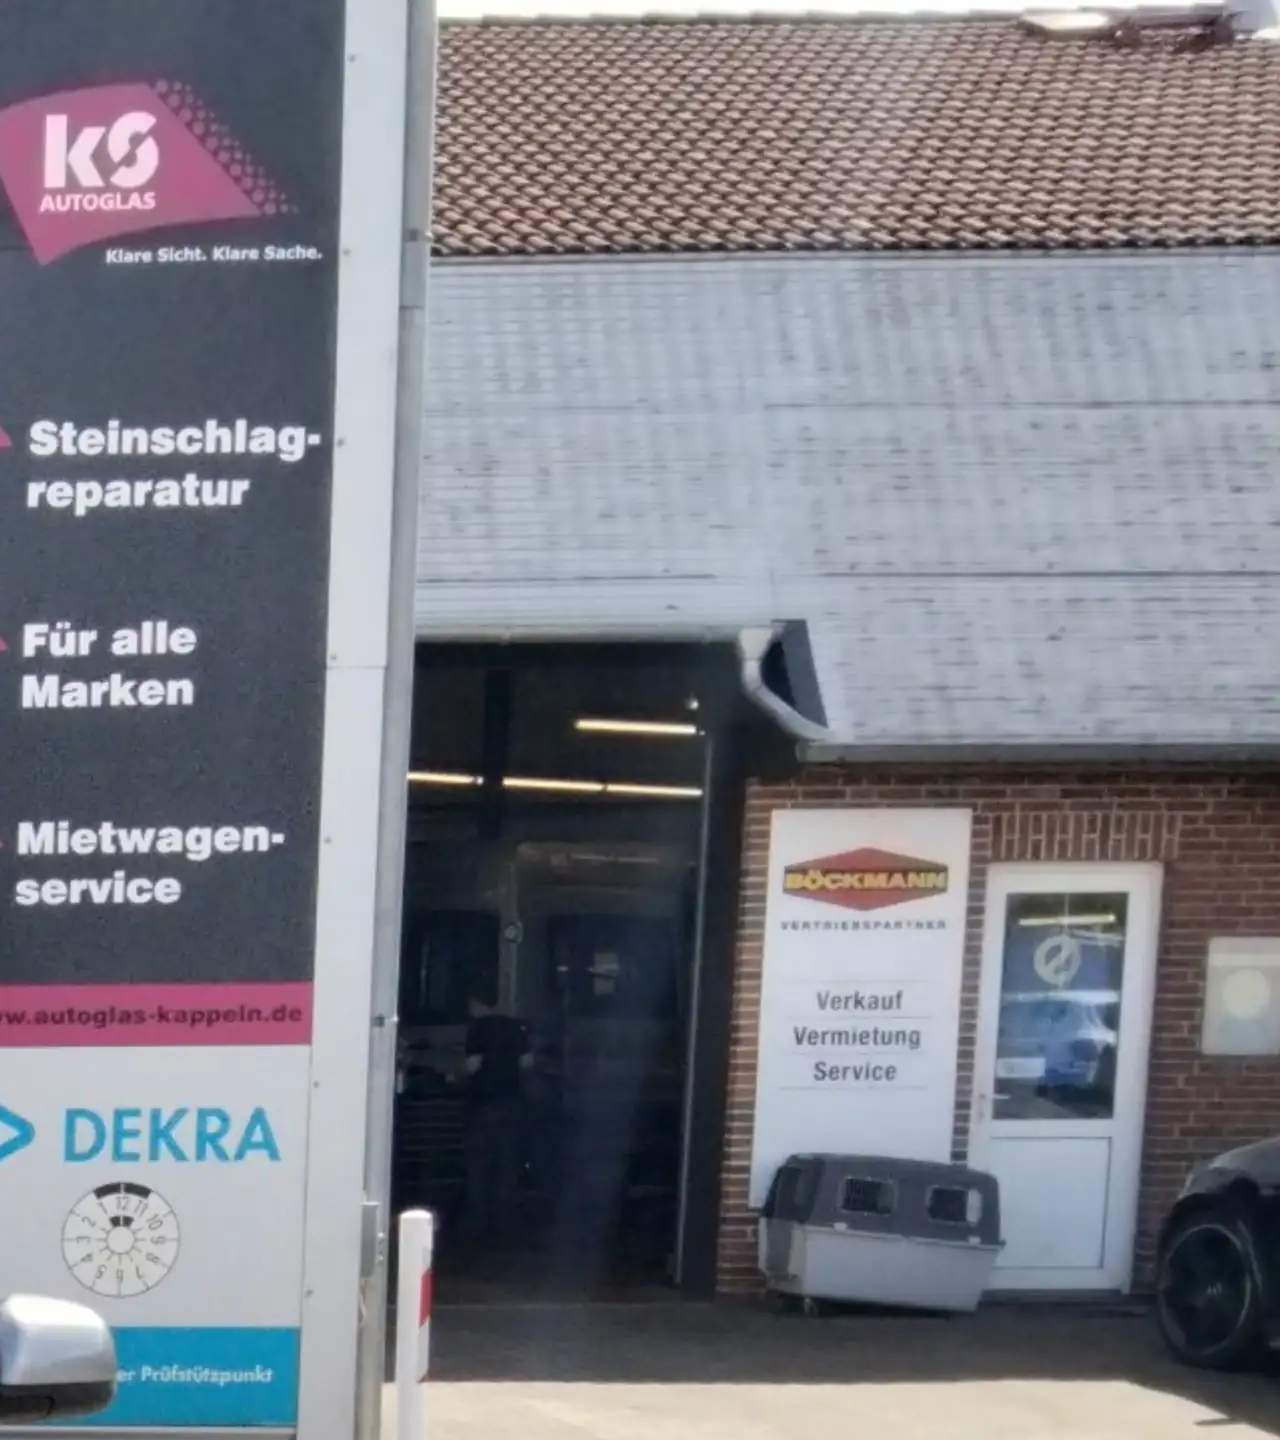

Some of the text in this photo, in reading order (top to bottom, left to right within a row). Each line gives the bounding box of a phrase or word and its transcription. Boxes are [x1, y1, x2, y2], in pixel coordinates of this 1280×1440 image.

[39, 191, 156, 213] AUTOGLAS
[105, 244, 322, 264] Klare Sicht. Klare Sache.
[29, 418, 321, 462] Steinschlag-
[27, 473, 250, 516] reparatur
[23, 620, 197, 658] Für alle
[21, 673, 194, 708] Marken
[17, 820, 285, 862] Mietwagen-
[15, 870, 182, 906] service
[784, 870, 946, 890] BÖCKMANN
[781, 919, 946, 931] VERTRIEBSPARTNER
[817, 990, 903, 1011] Verkauf
[793, 1027, 921, 1050] Vermietung
[813, 1061, 897, 1081] Service
[64, 1107, 280, 1163] DEKRA
